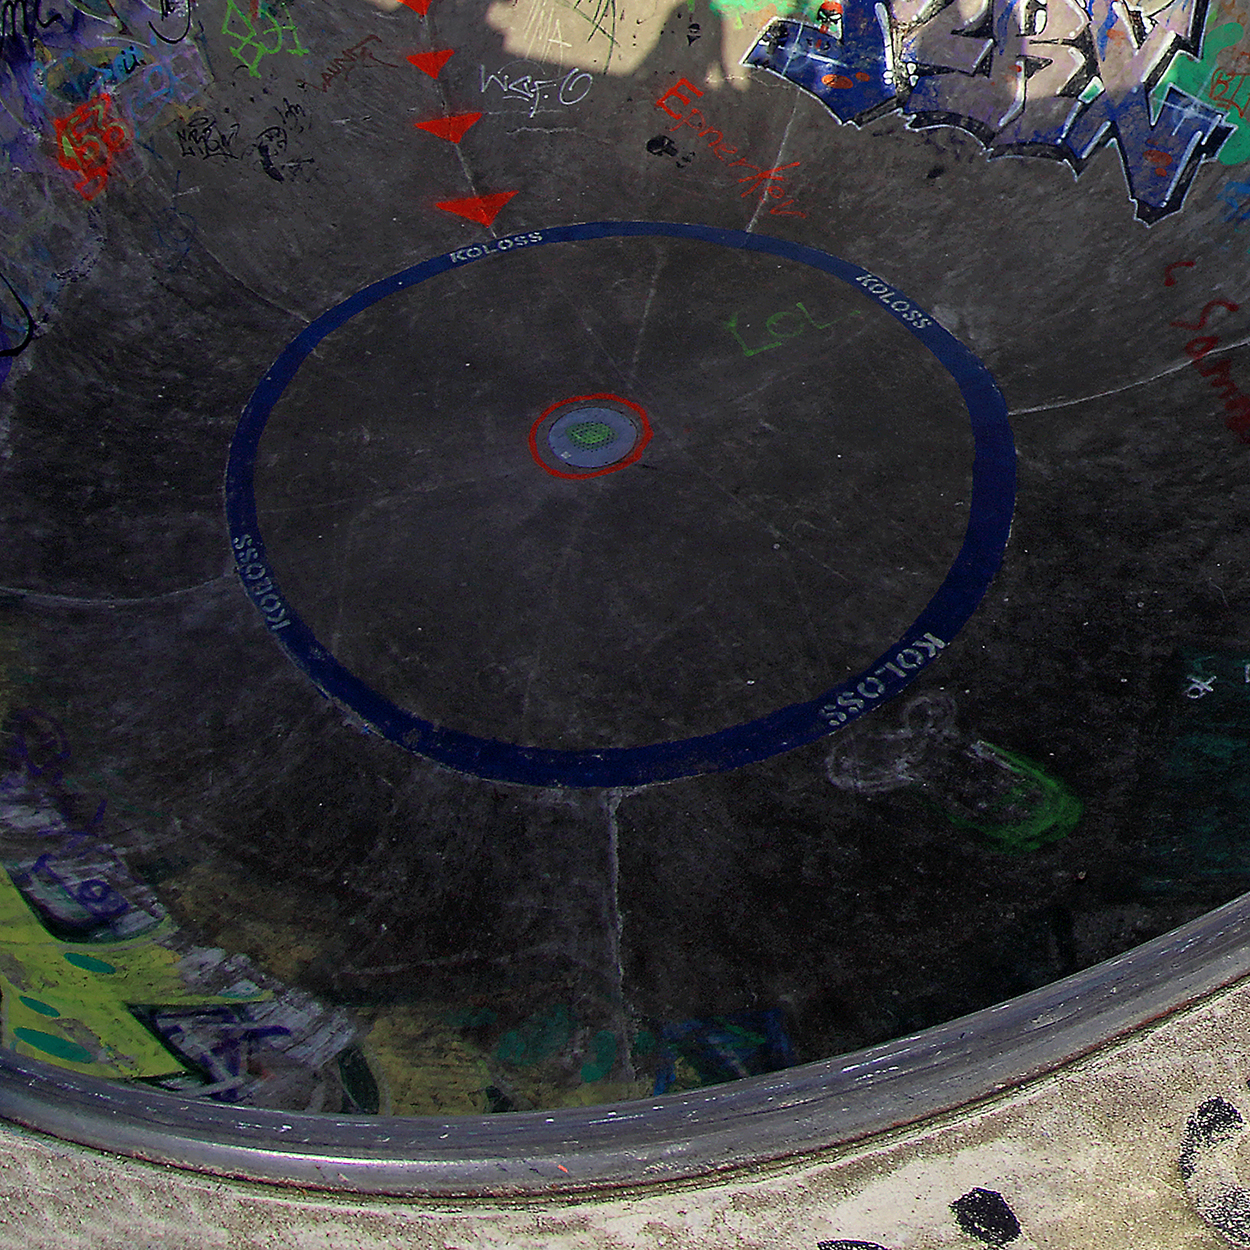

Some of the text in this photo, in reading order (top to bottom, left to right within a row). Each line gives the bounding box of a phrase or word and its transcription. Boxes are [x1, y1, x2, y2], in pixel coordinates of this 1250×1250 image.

[449, 230, 543, 263] KOLOSS
[855, 272, 932, 331] KOLOSS
[232, 533, 291, 630] KOLOSS
[820, 632, 947, 728] KOLOSS
